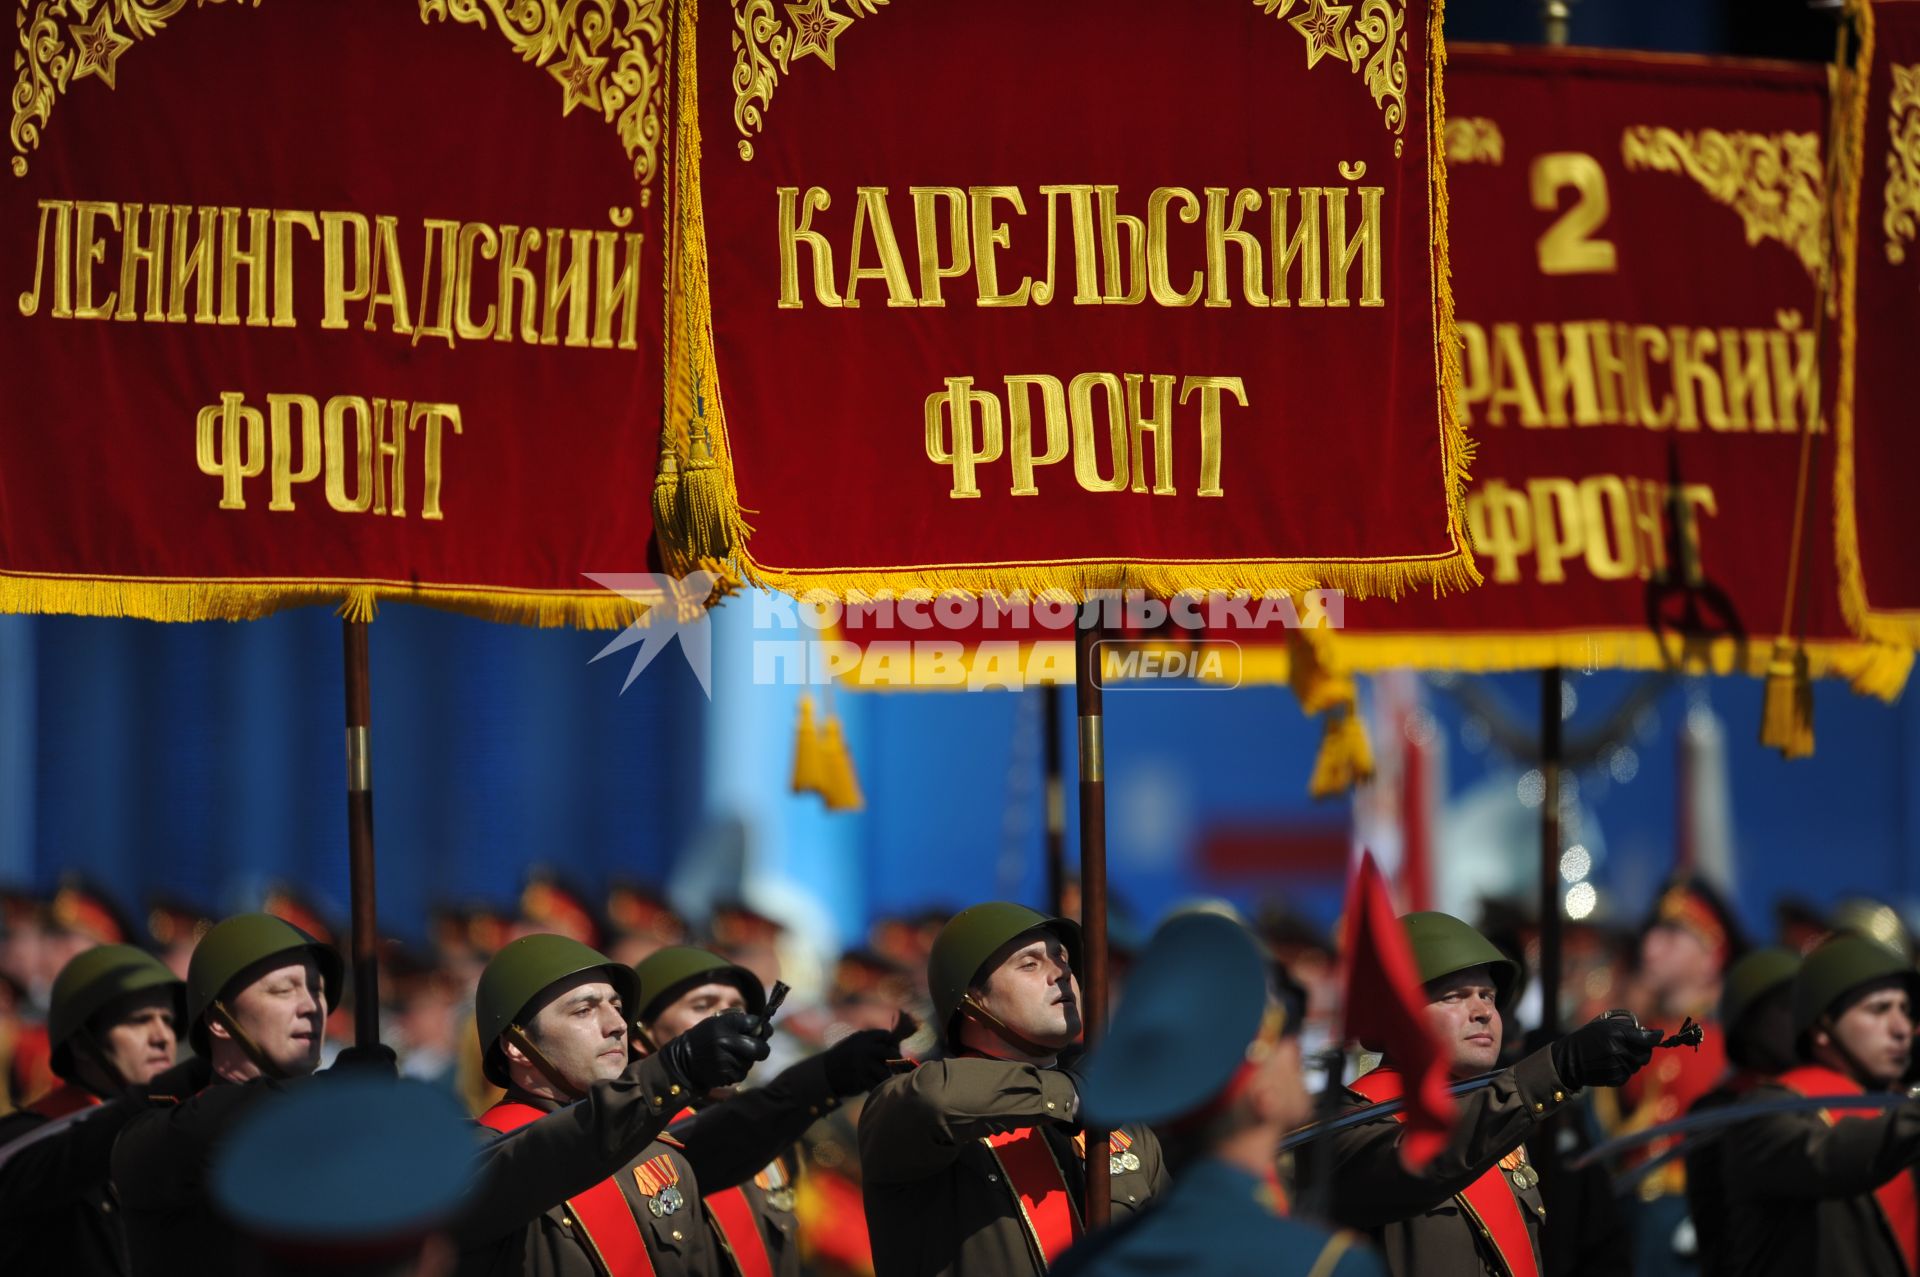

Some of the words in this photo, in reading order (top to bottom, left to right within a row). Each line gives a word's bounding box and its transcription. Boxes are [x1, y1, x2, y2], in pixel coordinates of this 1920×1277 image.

[18, 200, 644, 350] ЛЕНИНГРАДСКИЙ
[776, 160, 1385, 309] КАРЕЛЬСКИЙ
[1530, 152, 1617, 274] 2
[196, 391, 463, 520] ФРОНТ
[924, 372, 1249, 498] ФРОНТ
